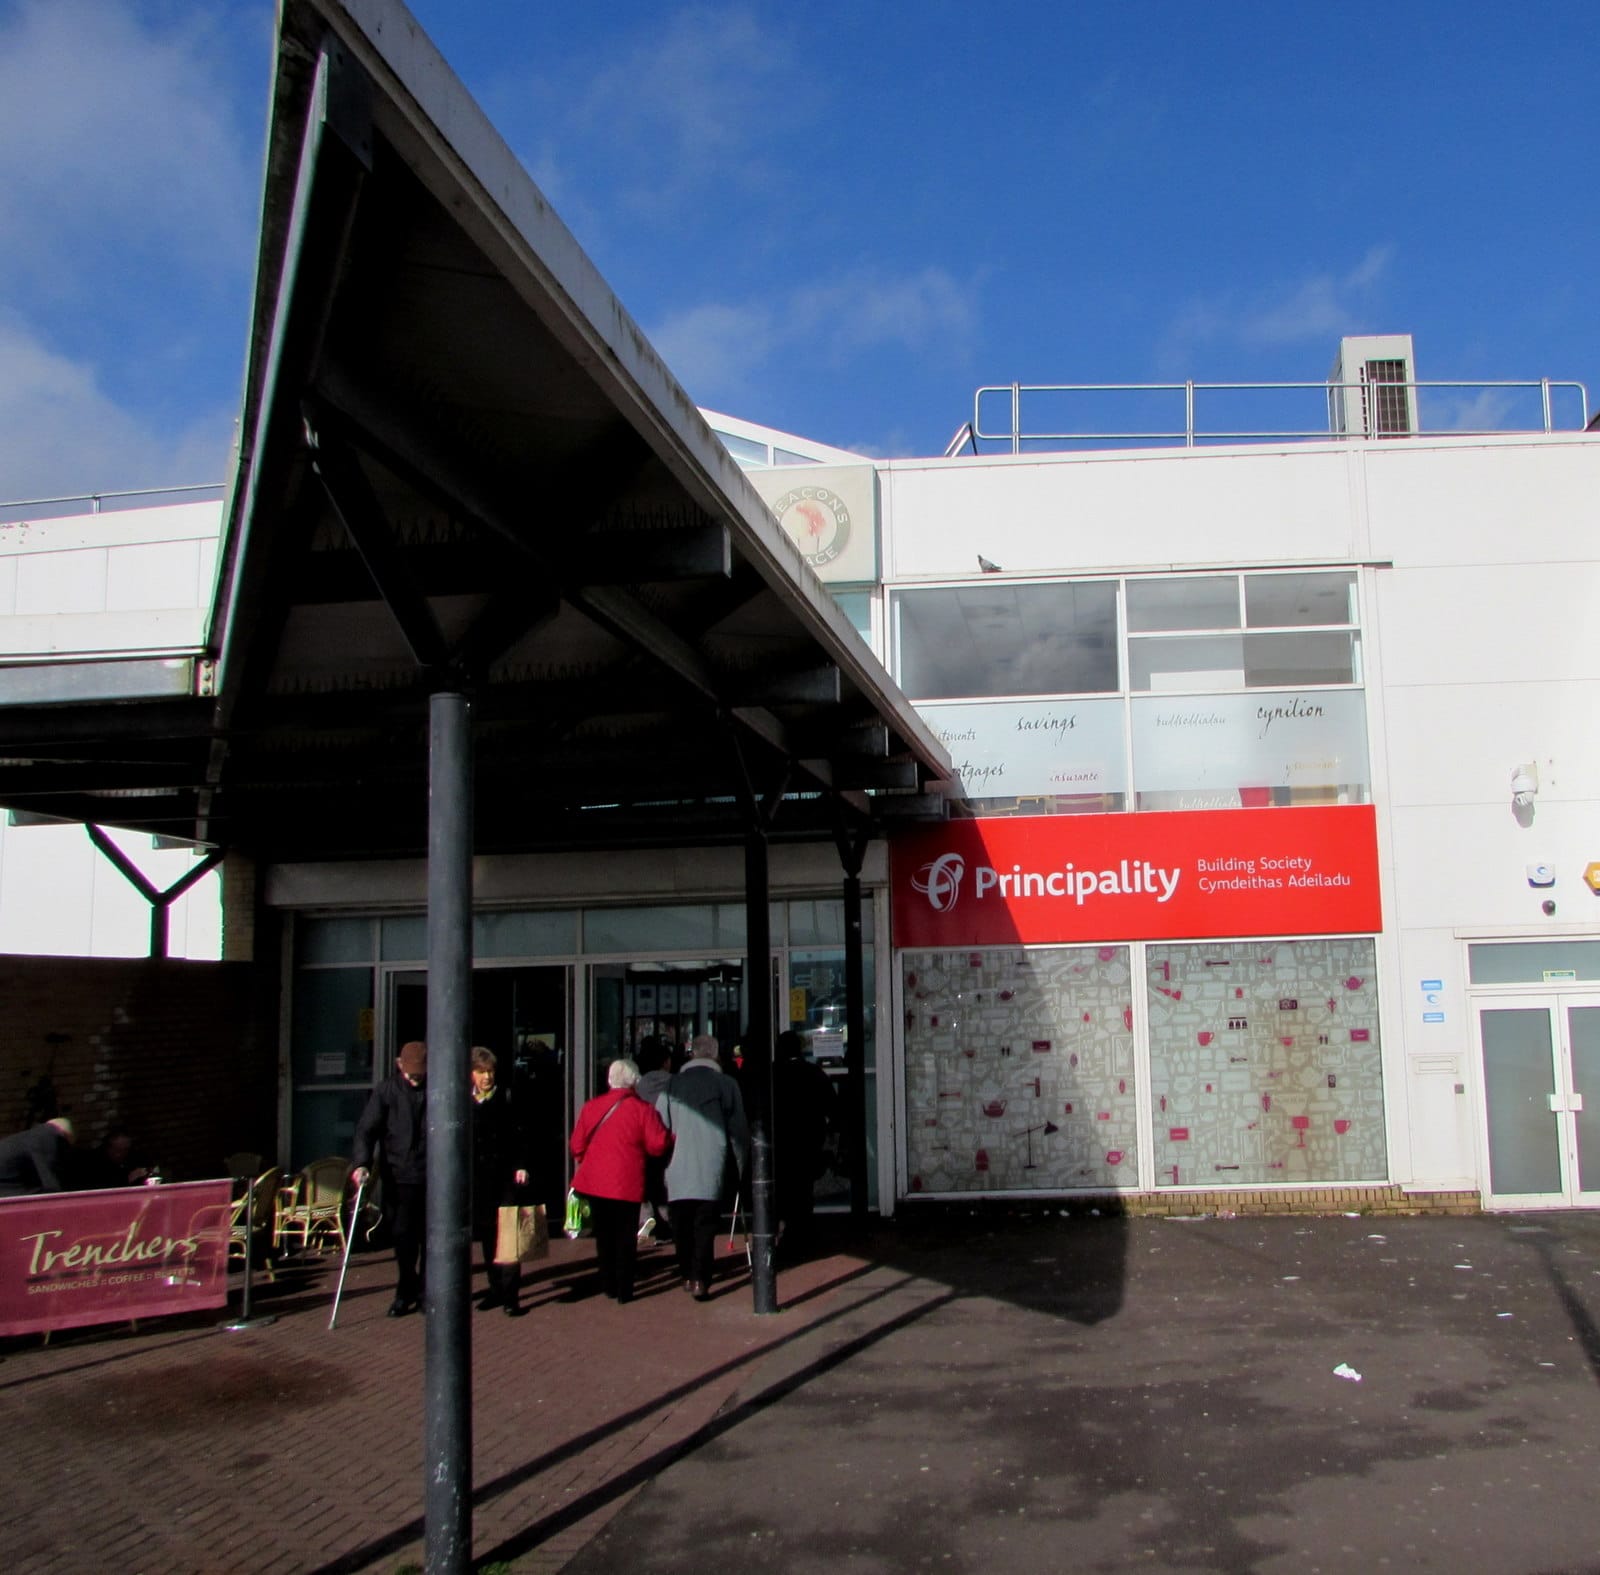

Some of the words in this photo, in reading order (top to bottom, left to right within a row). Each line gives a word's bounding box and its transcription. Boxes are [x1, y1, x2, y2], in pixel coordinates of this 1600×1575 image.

[776, 487, 848, 523] EACONS
[1017, 712, 1076, 746] savings
[1257, 697, 1323, 739] cynilion
[1049, 770, 1098, 782] insurance
[1197, 857, 1256, 873] Building
[1260, 856, 1312, 872] Society
[975, 859, 1181, 906] Principality
[1199, 875, 1283, 894] Cymdeithas
[1288, 872, 1350, 888] Adeiladu
[19, 1221, 199, 1275] Trenchers
[27, 1278, 98, 1295] SANDWICHES
[108, 1273, 144, 1286] COFFEE
